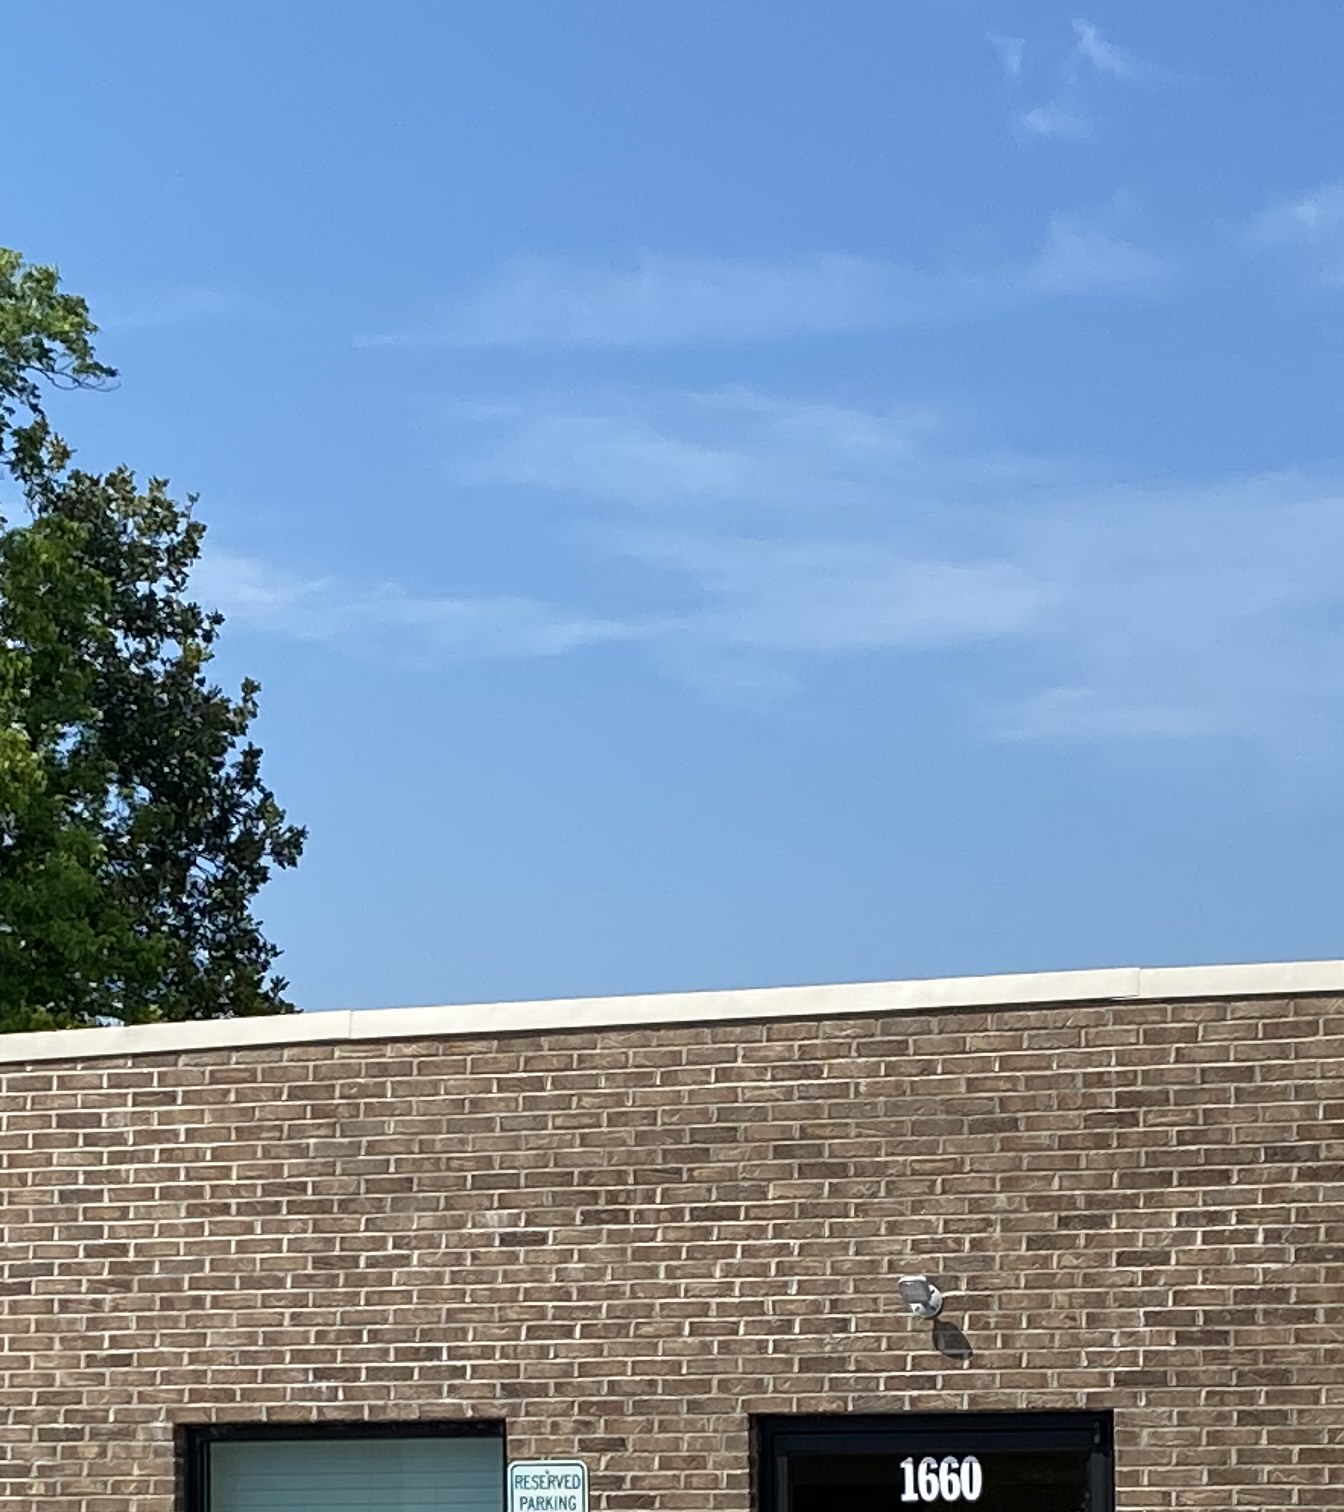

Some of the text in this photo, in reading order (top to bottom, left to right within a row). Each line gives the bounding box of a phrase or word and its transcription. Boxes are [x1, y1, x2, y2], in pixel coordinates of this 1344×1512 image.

[514, 1474, 581, 1490] RESERVED
[899, 1455, 983, 1502] 1660
[519, 1495, 577, 1511] PARKING
